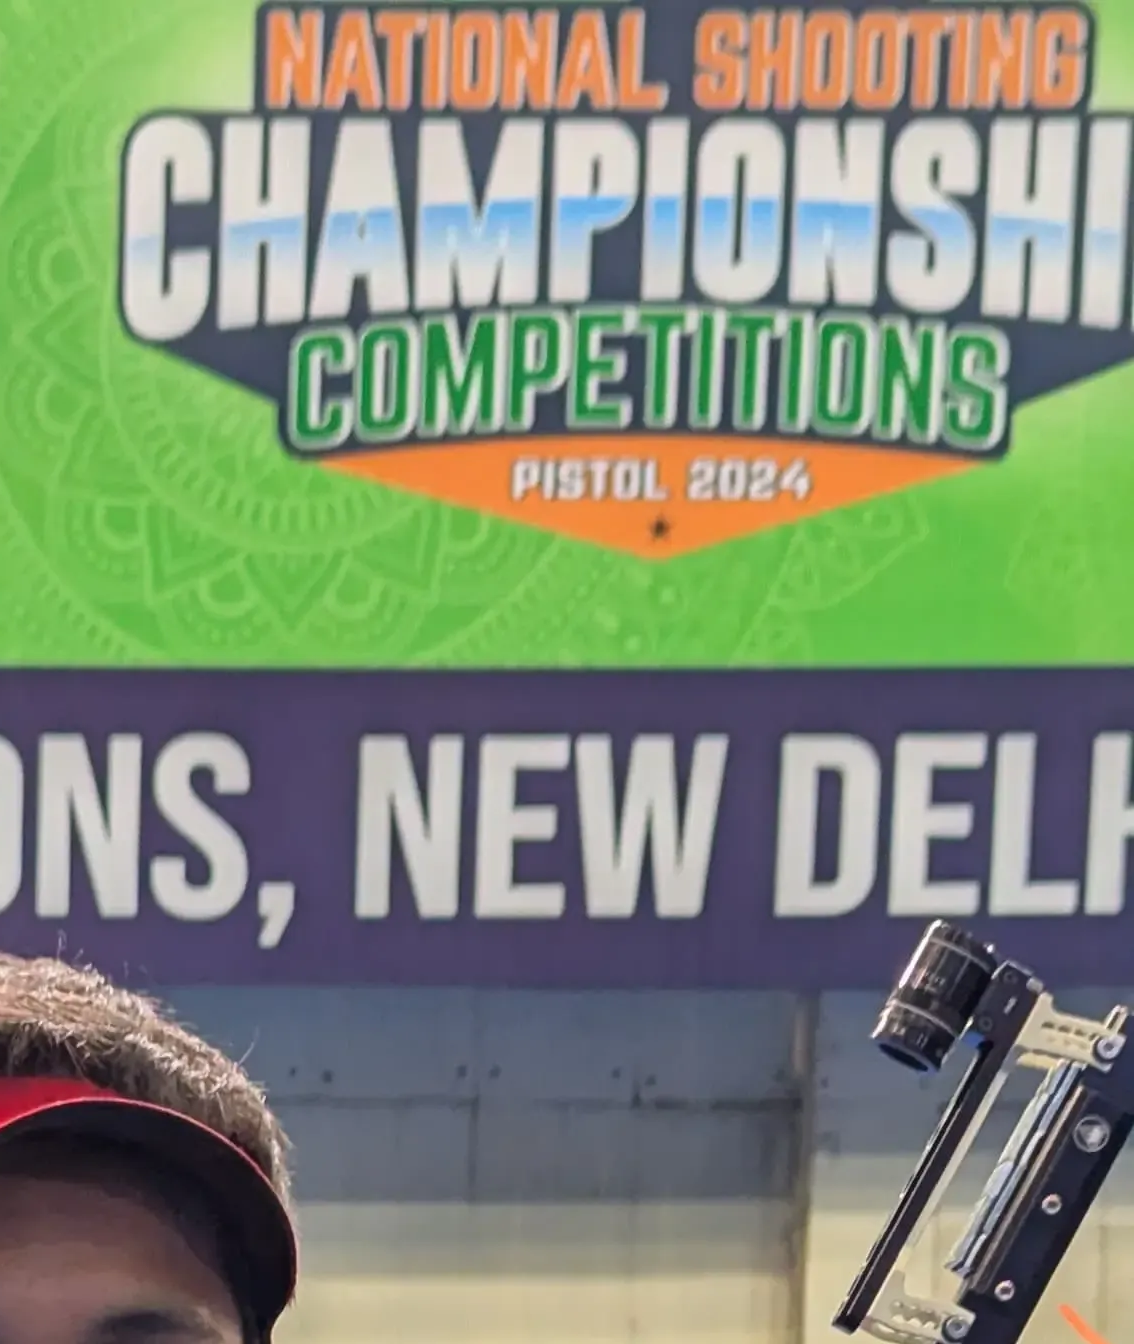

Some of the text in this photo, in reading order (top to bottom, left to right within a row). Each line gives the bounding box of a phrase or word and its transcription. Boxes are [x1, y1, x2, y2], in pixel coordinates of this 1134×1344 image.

[268, 4, 1090, 111] NATIONAL SHOOTING
[122, 114, 1134, 340] CHAMPIONSHI
[290, 304, 1011, 450] COMPETITIONS
[511, 457, 811, 500] PISTOL 2024
[354, 733, 730, 920] NEW
